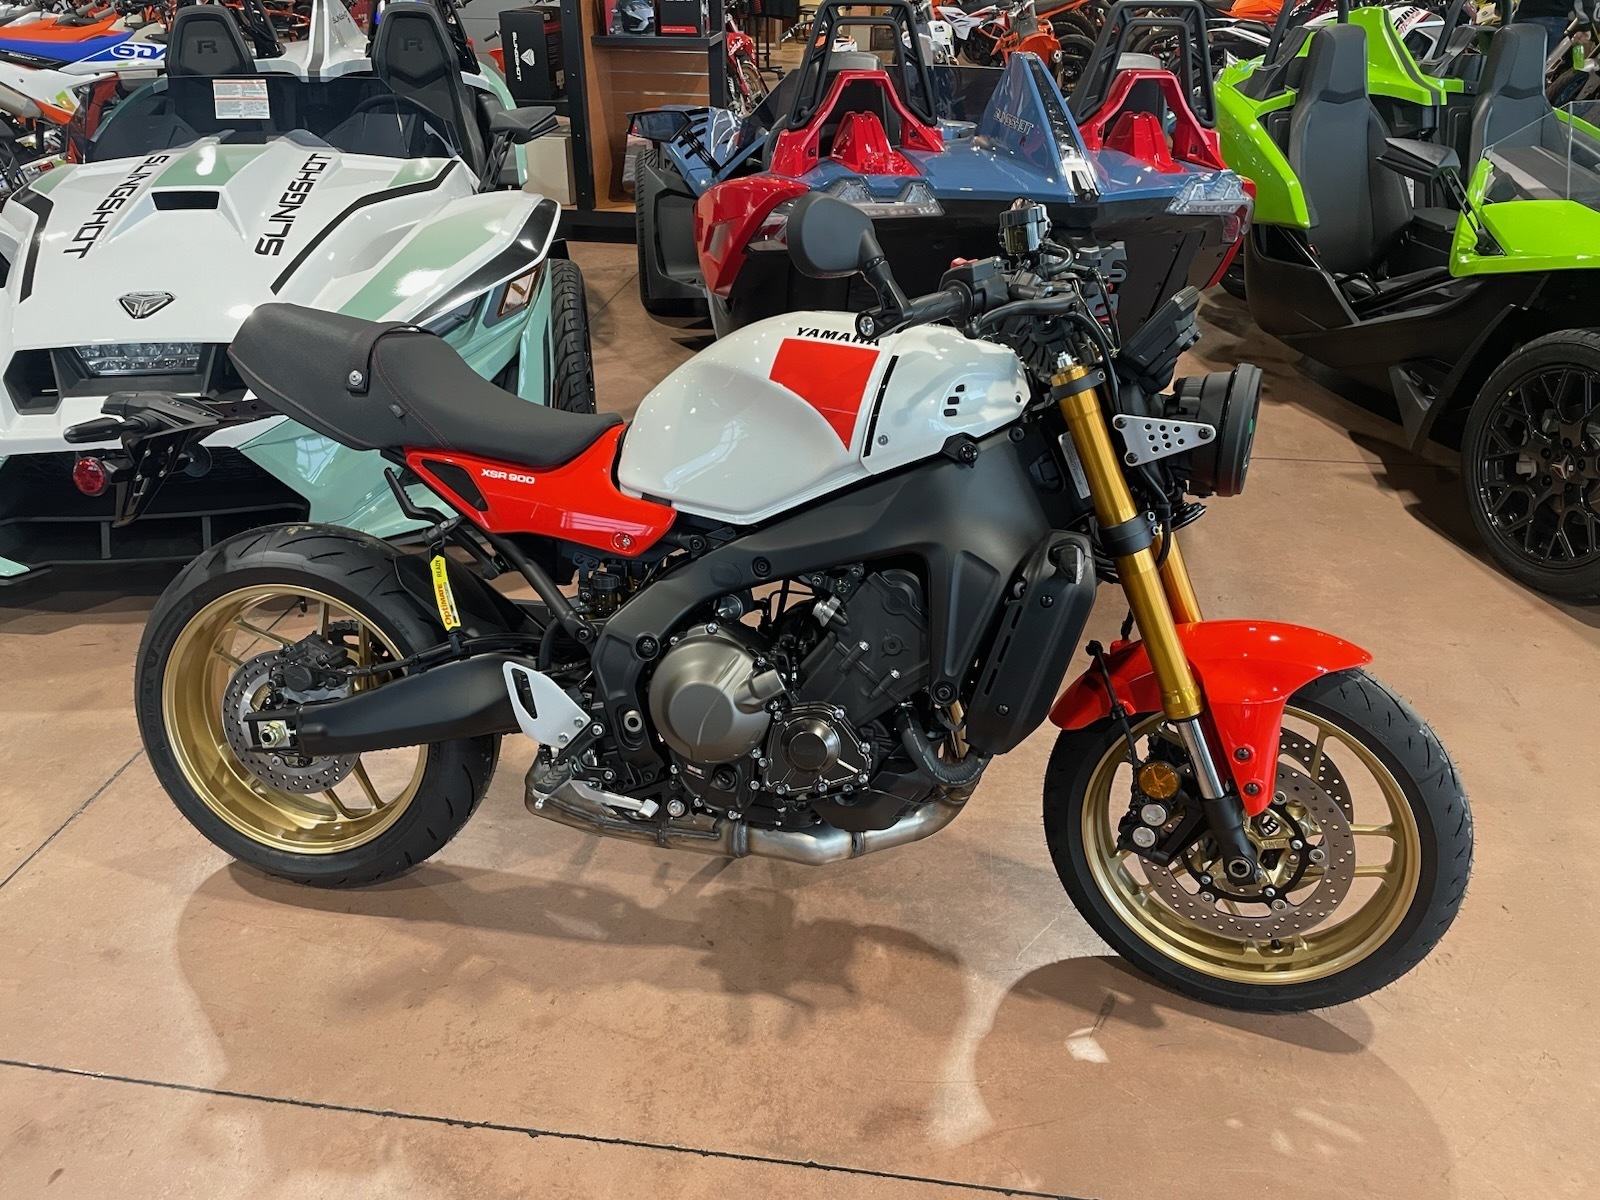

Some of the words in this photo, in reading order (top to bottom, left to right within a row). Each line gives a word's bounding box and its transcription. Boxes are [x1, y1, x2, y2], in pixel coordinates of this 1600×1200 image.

[196, 39, 218, 54] R
[512, 31, 522, 81] SLINGSHOT
[63, 155, 170, 259] SLINGSHOT
[254, 153, 333, 256] SLINGSHOT
[481, 468, 507, 480] XSR
[508, 473, 536, 485] 900
